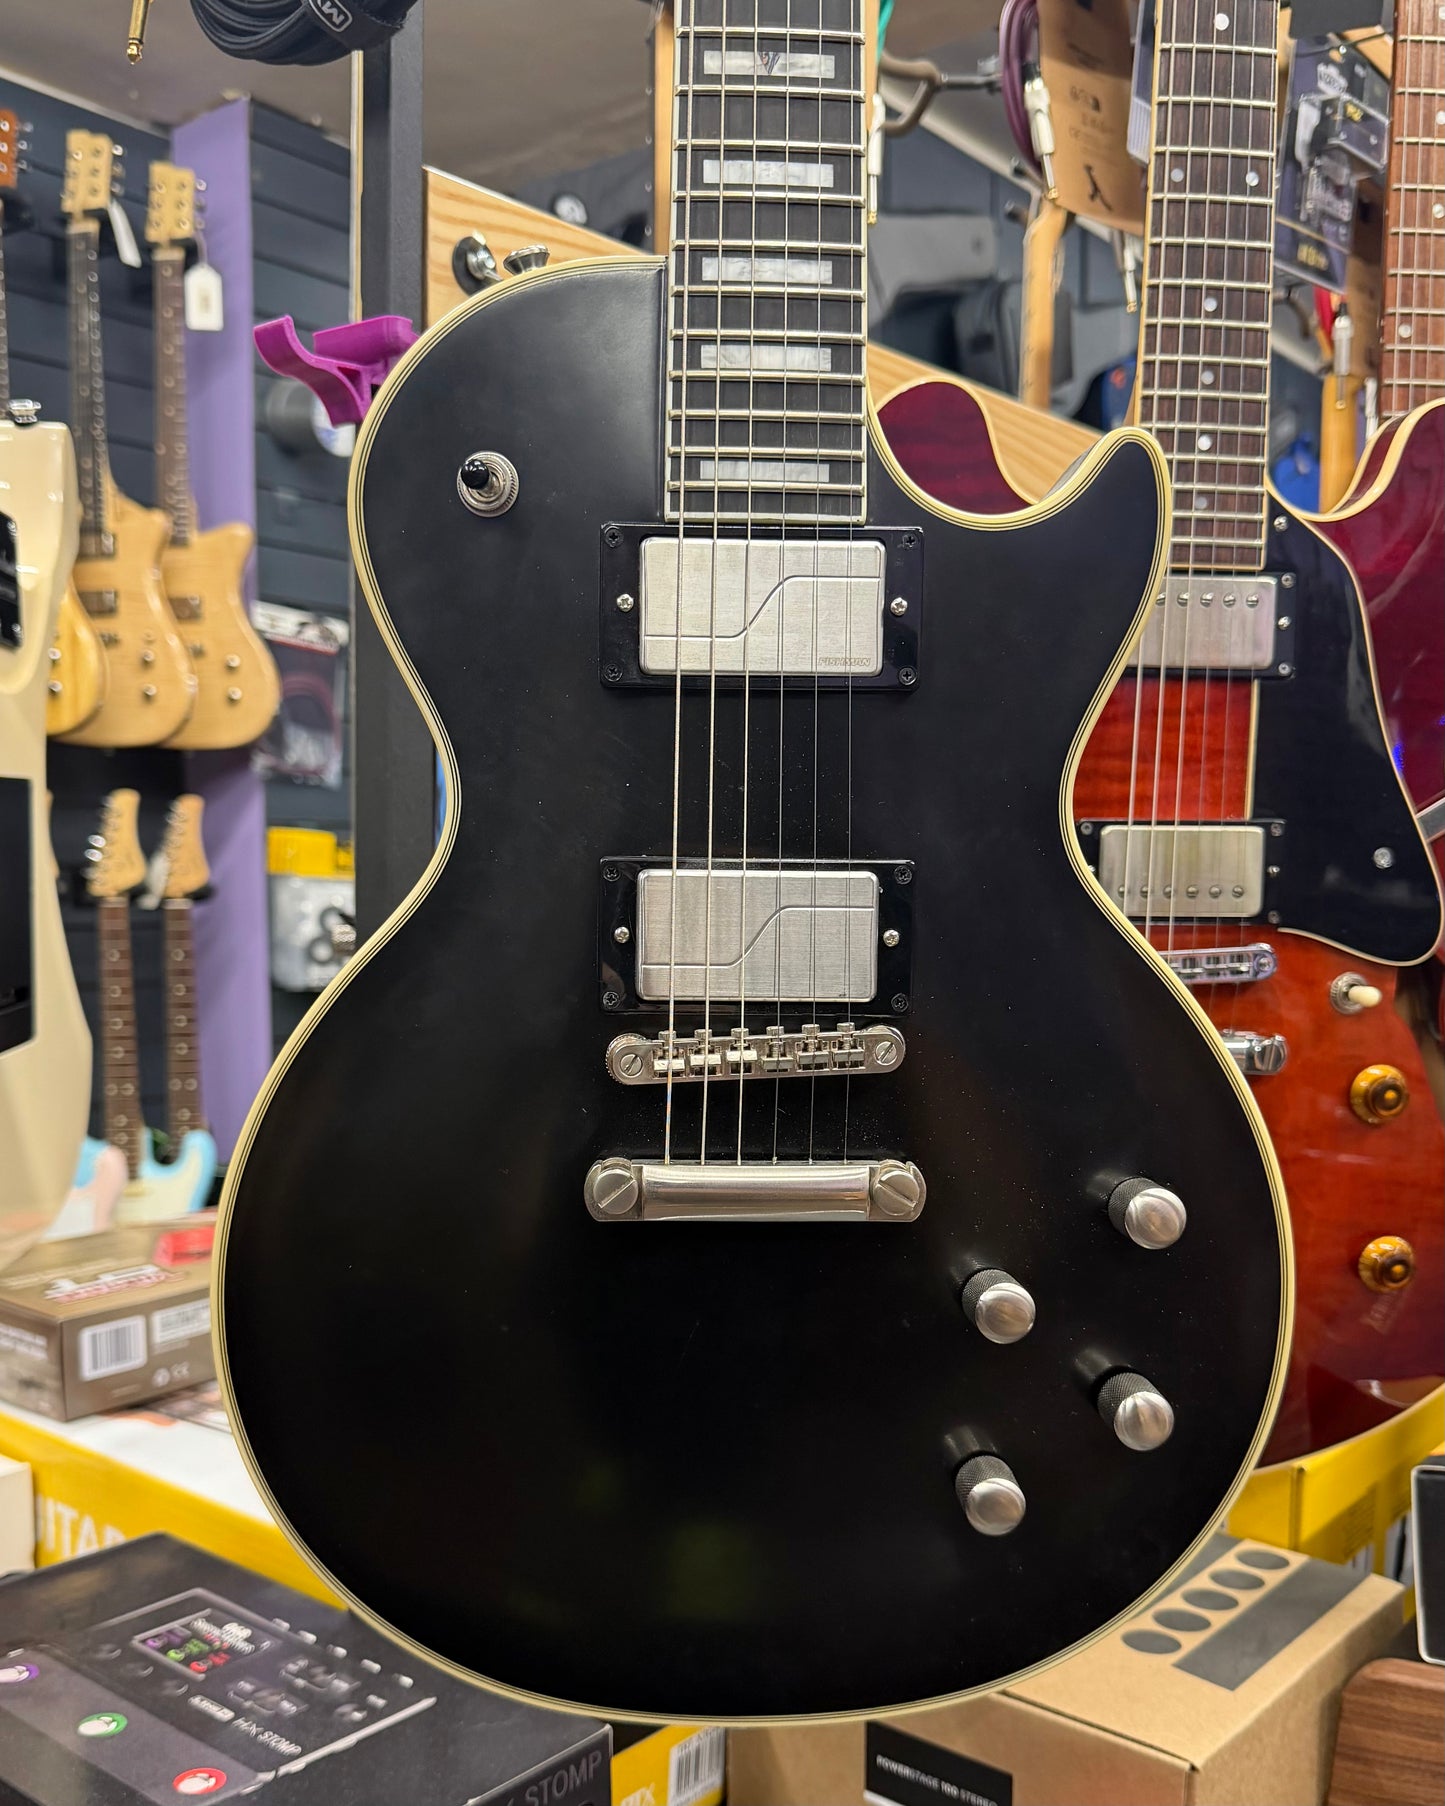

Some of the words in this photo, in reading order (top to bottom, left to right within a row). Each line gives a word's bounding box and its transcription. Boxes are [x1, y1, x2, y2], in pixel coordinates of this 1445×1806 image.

[818, 657, 871, 667] FISHMAN
[35, 1493, 127, 1559] ITA
[257, 1730, 302, 1757] STOMP
[524, 1750, 602, 1806] STOMP
